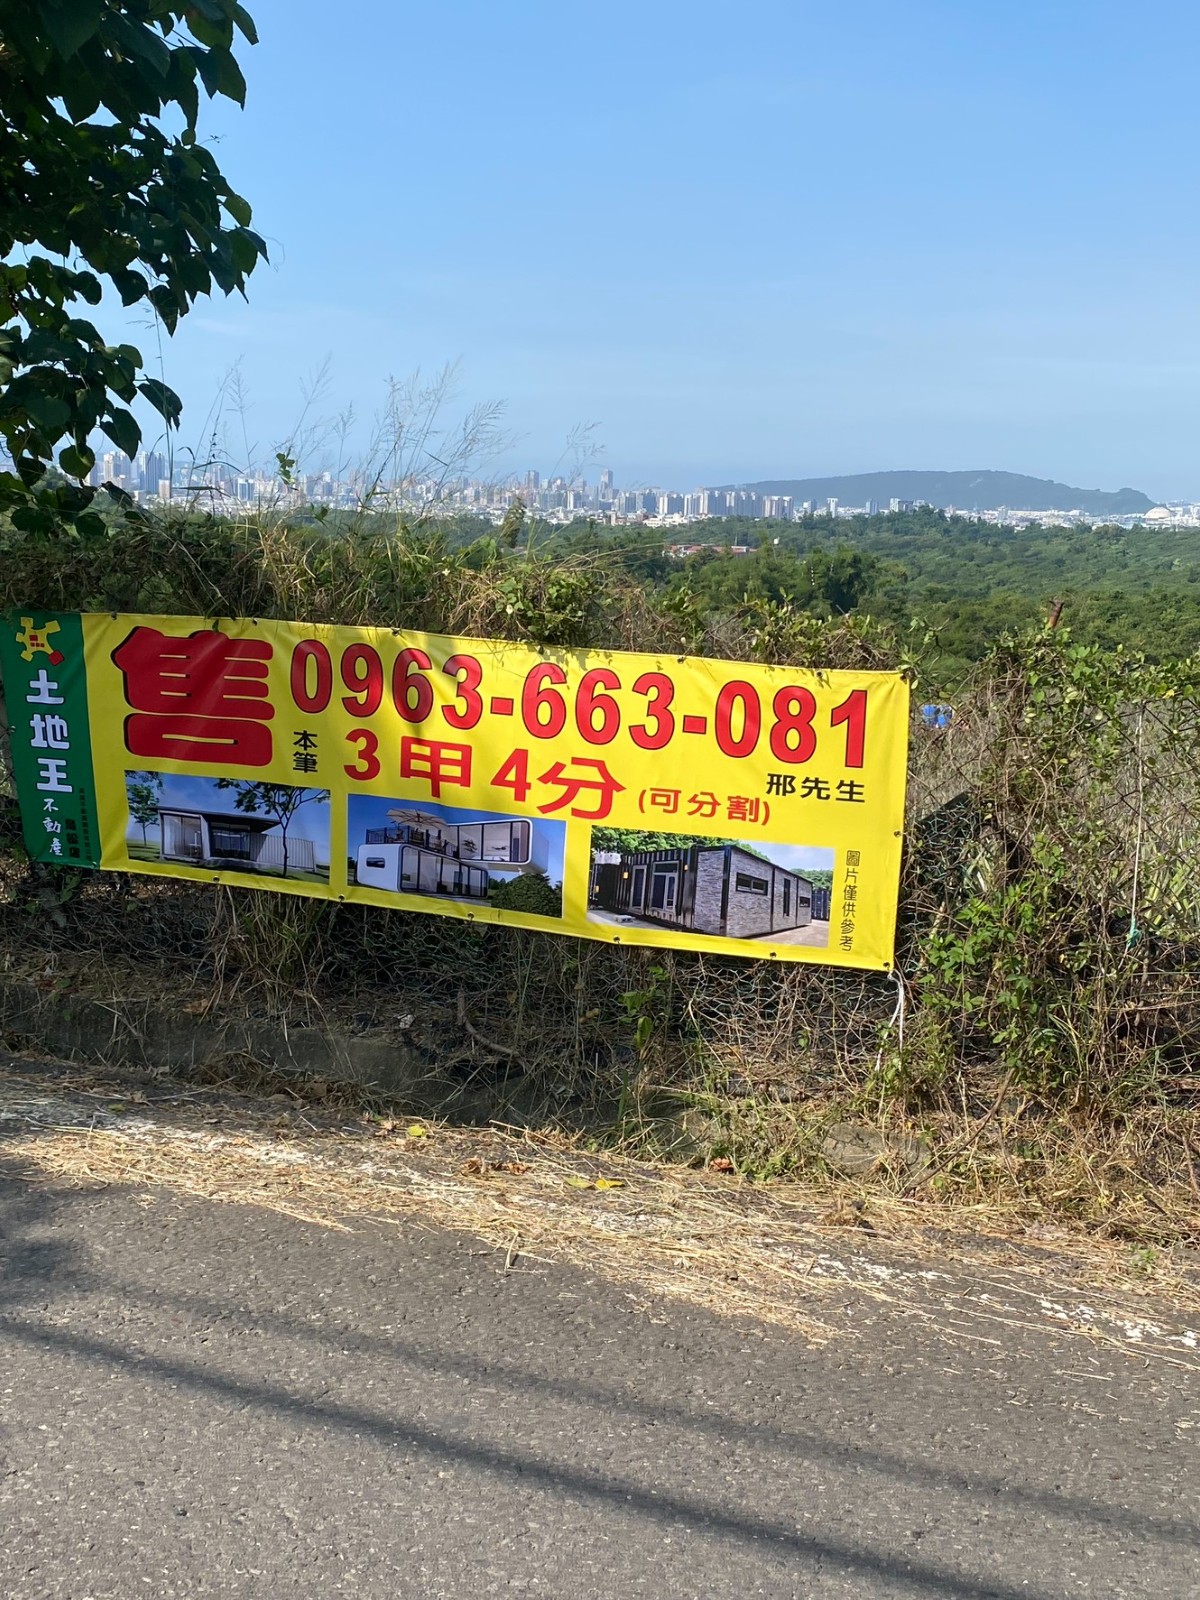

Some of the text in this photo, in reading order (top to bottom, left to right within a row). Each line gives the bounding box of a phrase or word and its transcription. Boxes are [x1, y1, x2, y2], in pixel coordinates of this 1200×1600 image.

[26, 669, 73, 793] 土地王
[111, 626, 275, 766] 售
[290, 639, 867, 768] 0963-663-081
[292, 729, 319, 773] 本筆
[765, 772, 866, 803] 邢先生
[42, 798, 64, 857] 不動產
[637, 787, 771, 826] (可分割)
[839, 850, 861, 952] 圖片僅供參考
